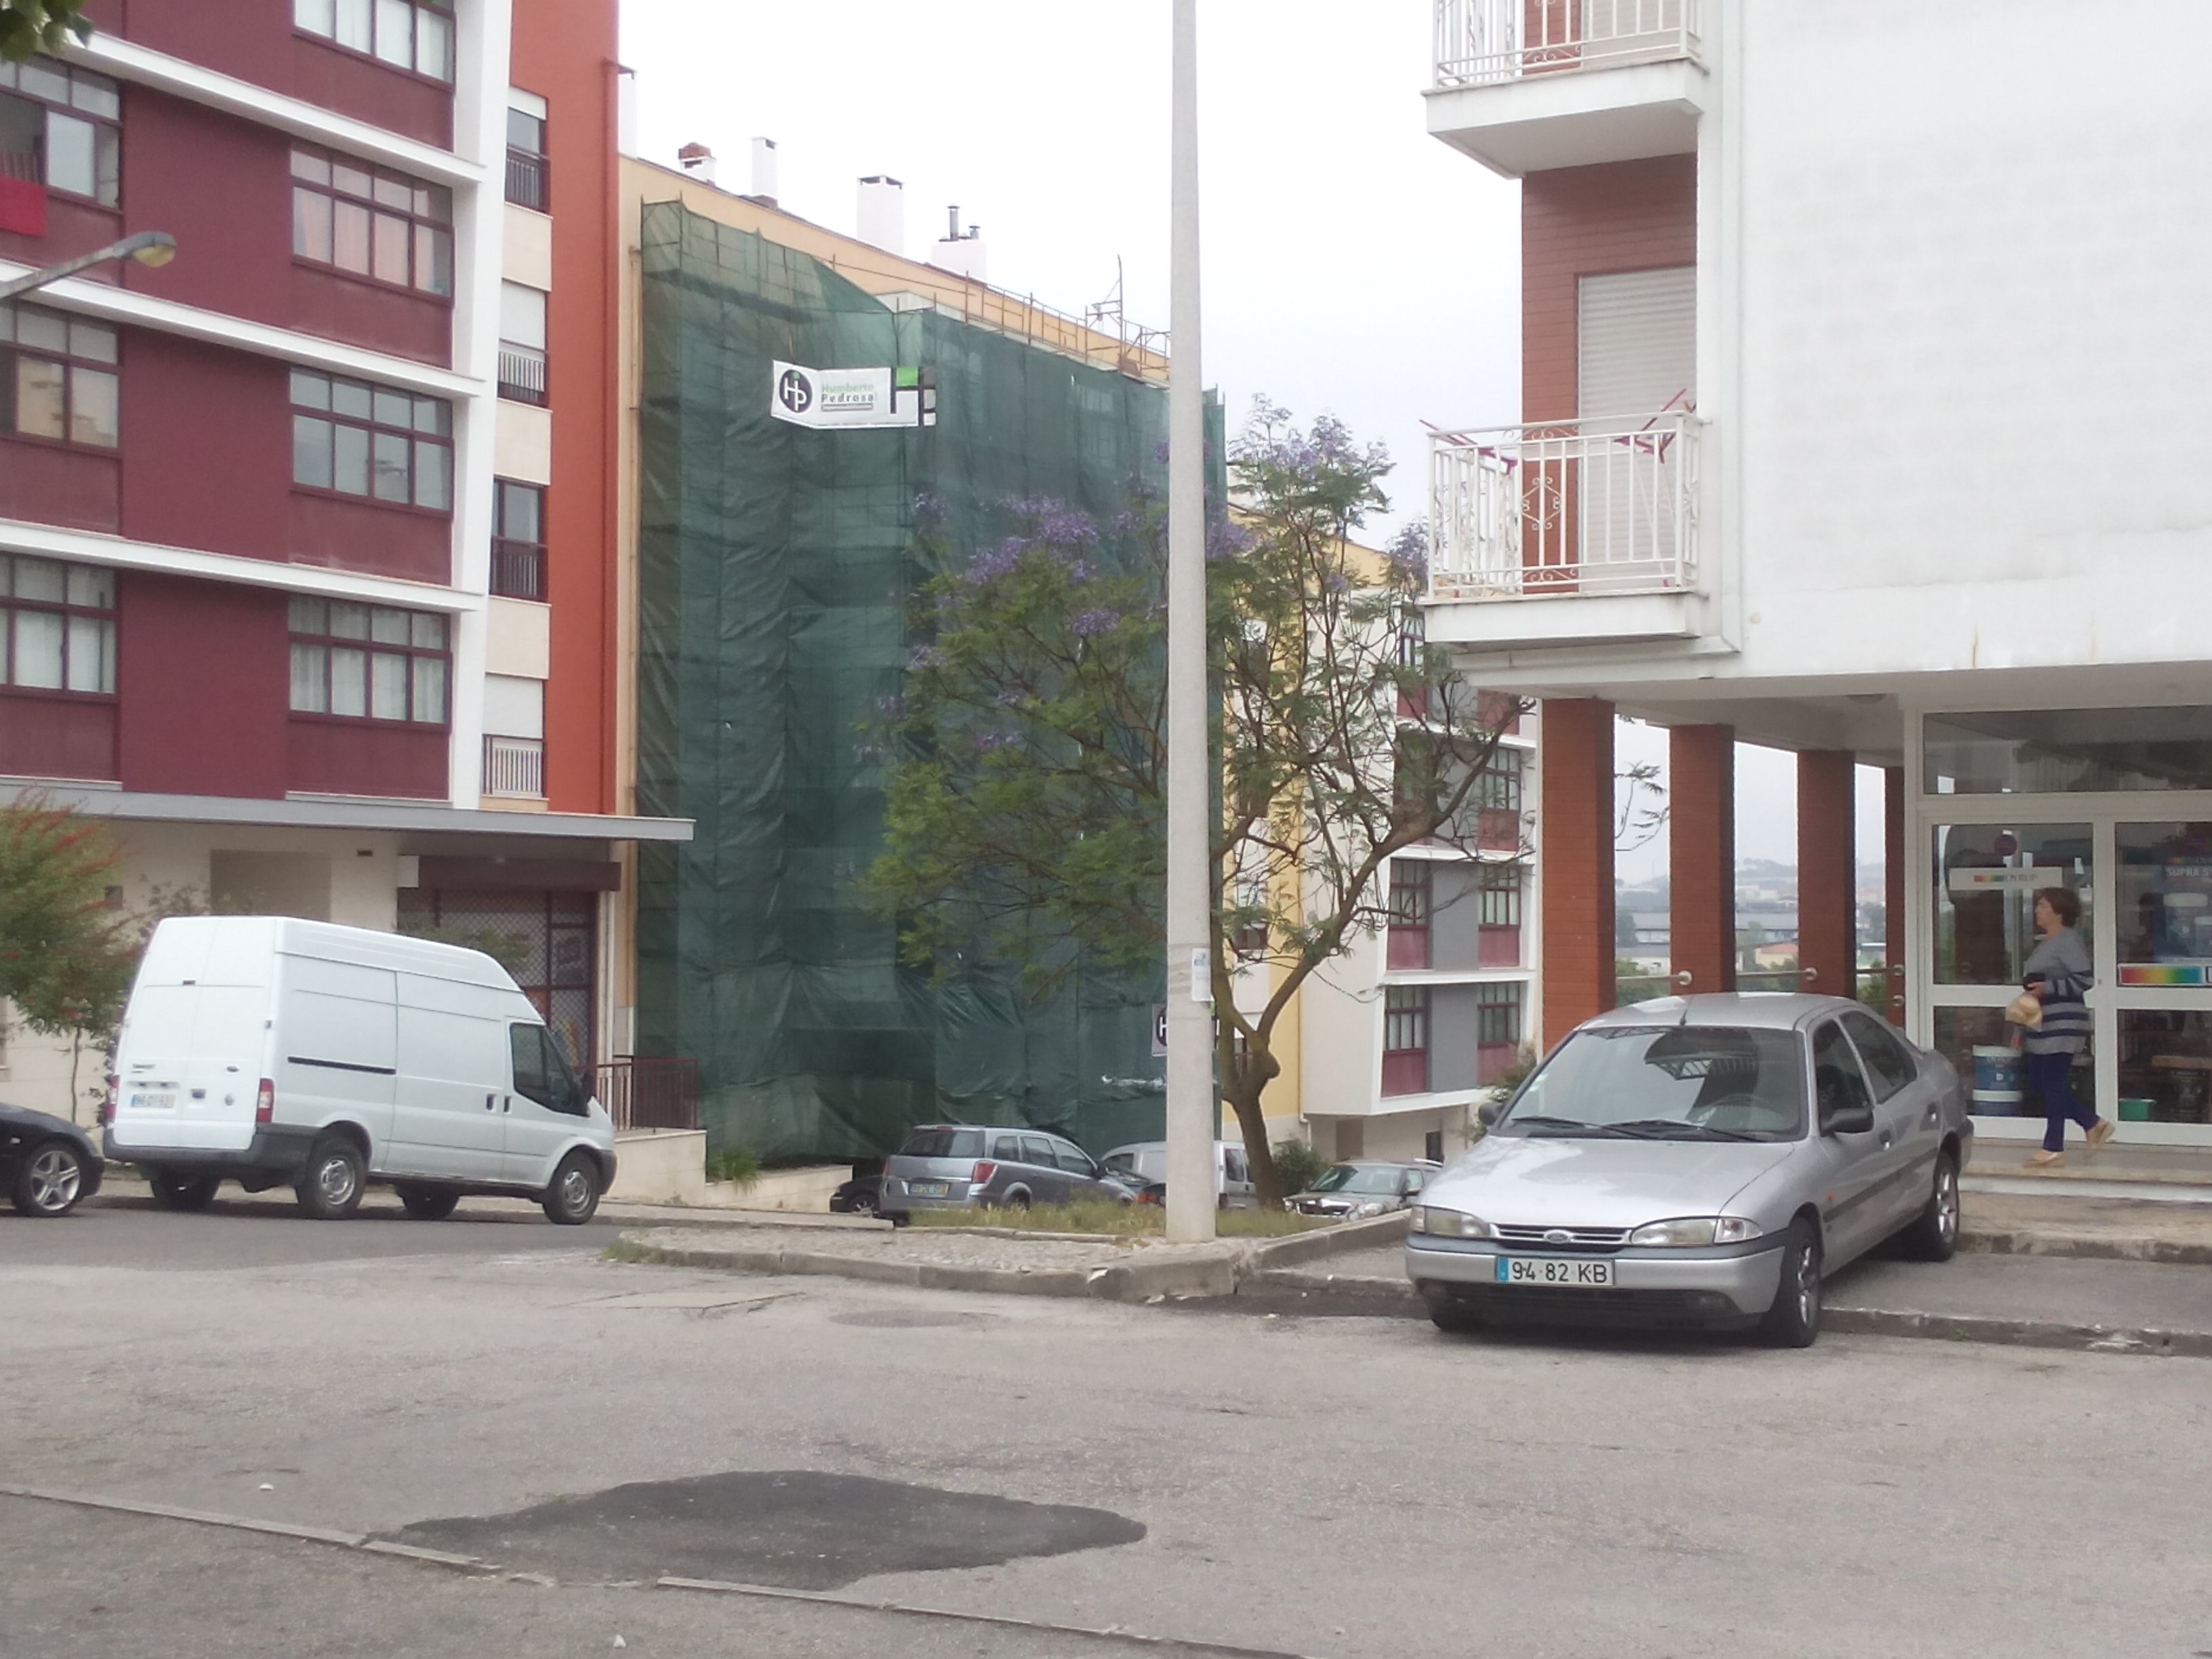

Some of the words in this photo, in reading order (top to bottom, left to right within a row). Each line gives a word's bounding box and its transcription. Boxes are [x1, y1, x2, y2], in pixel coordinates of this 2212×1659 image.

[821, 393, 874, 403] Pedrosa
[2167, 867, 2200, 877] SUPRA
[1512, 1261, 1536, 1280] 94
[1546, 1263, 1569, 1282] 82
[1578, 1263, 1607, 1283] KB
